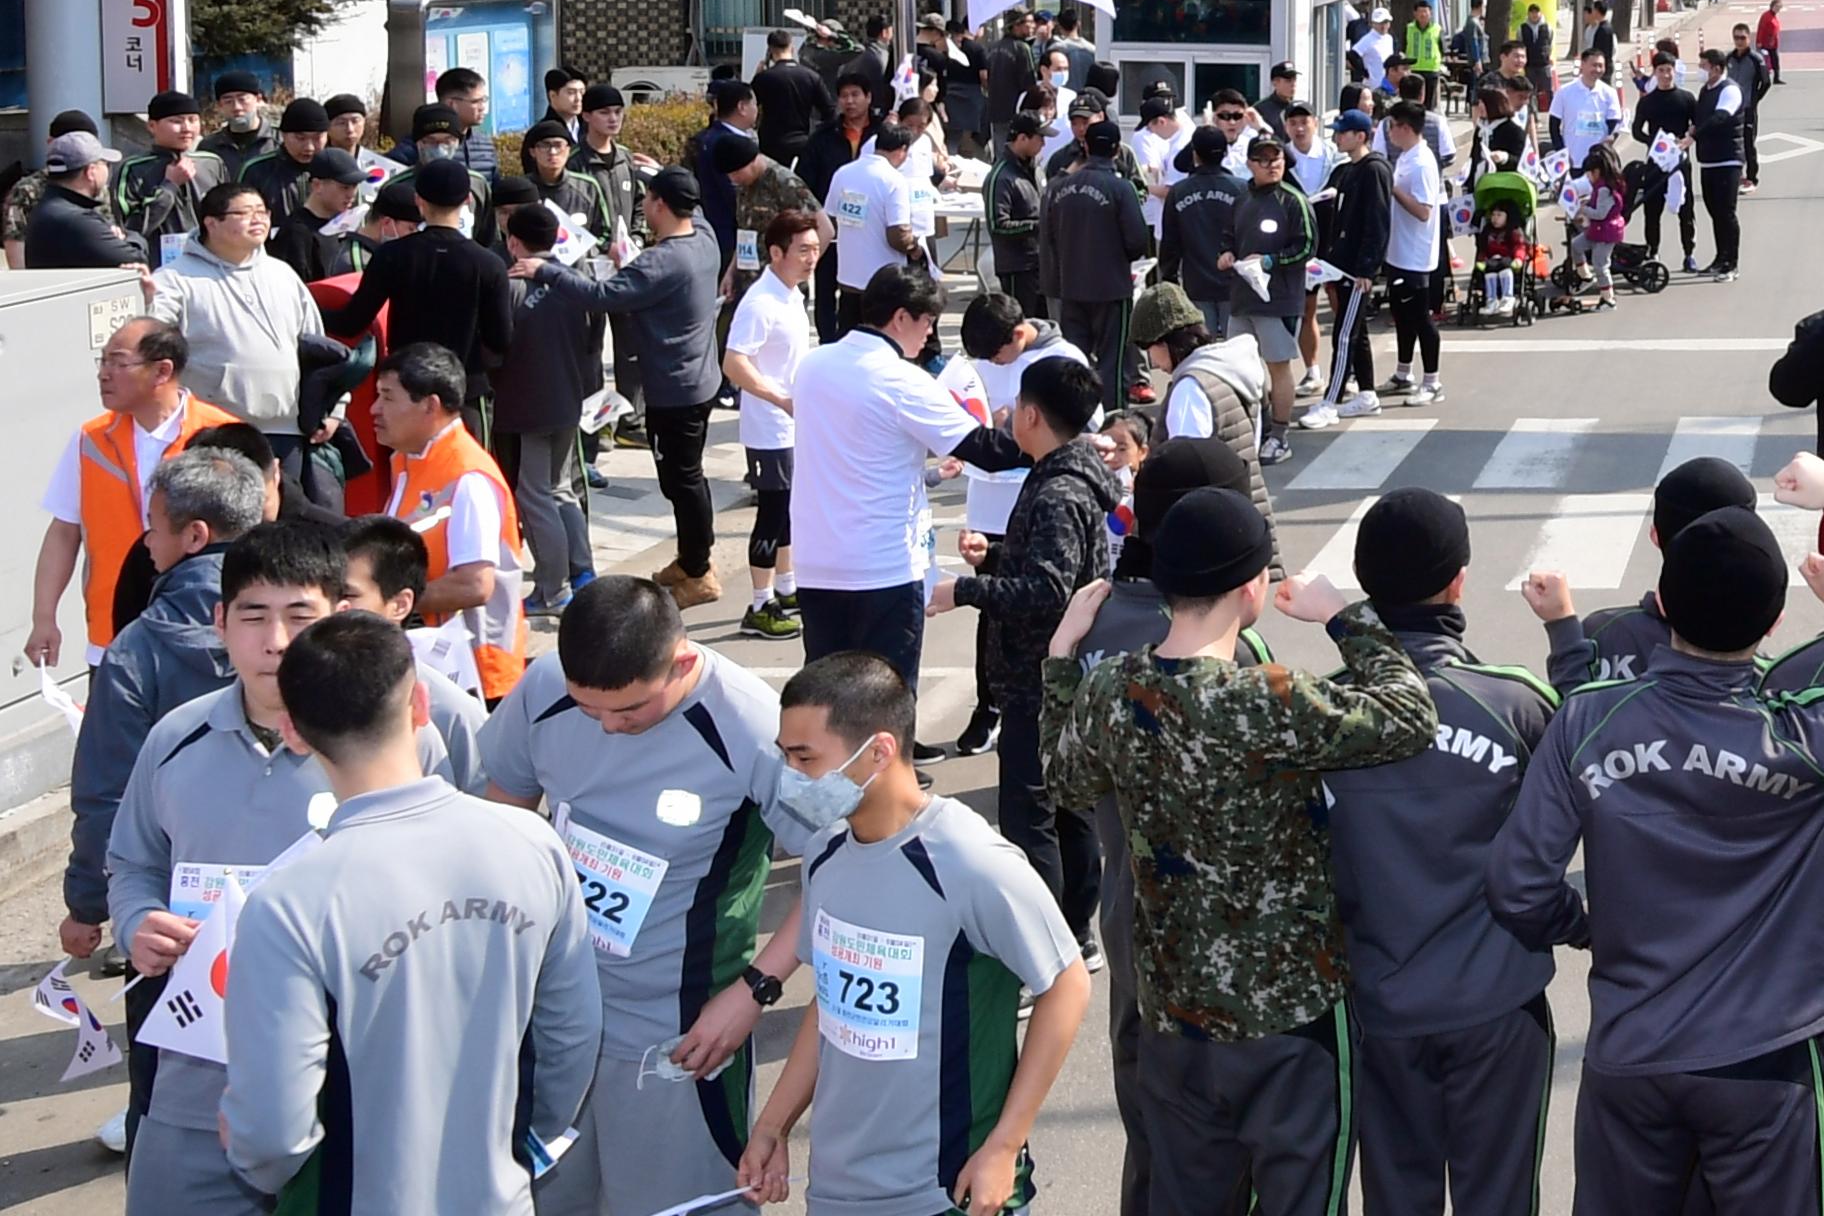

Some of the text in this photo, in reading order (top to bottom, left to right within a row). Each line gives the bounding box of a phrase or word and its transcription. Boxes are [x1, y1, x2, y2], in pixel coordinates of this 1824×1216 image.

[124, 36, 144, 74] 코너
[841, 201, 862, 215] 422
[1174, 189, 1236, 213] ROK ARM
[1596, 652, 1637, 682] OK
[1427, 724, 1518, 775] RMY
[1581, 740, 1815, 802] ROK ARMY
[359, 897, 536, 985] ROK ARMY
[838, 969, 901, 1015] 723
[852, 1030, 896, 1052] high1
